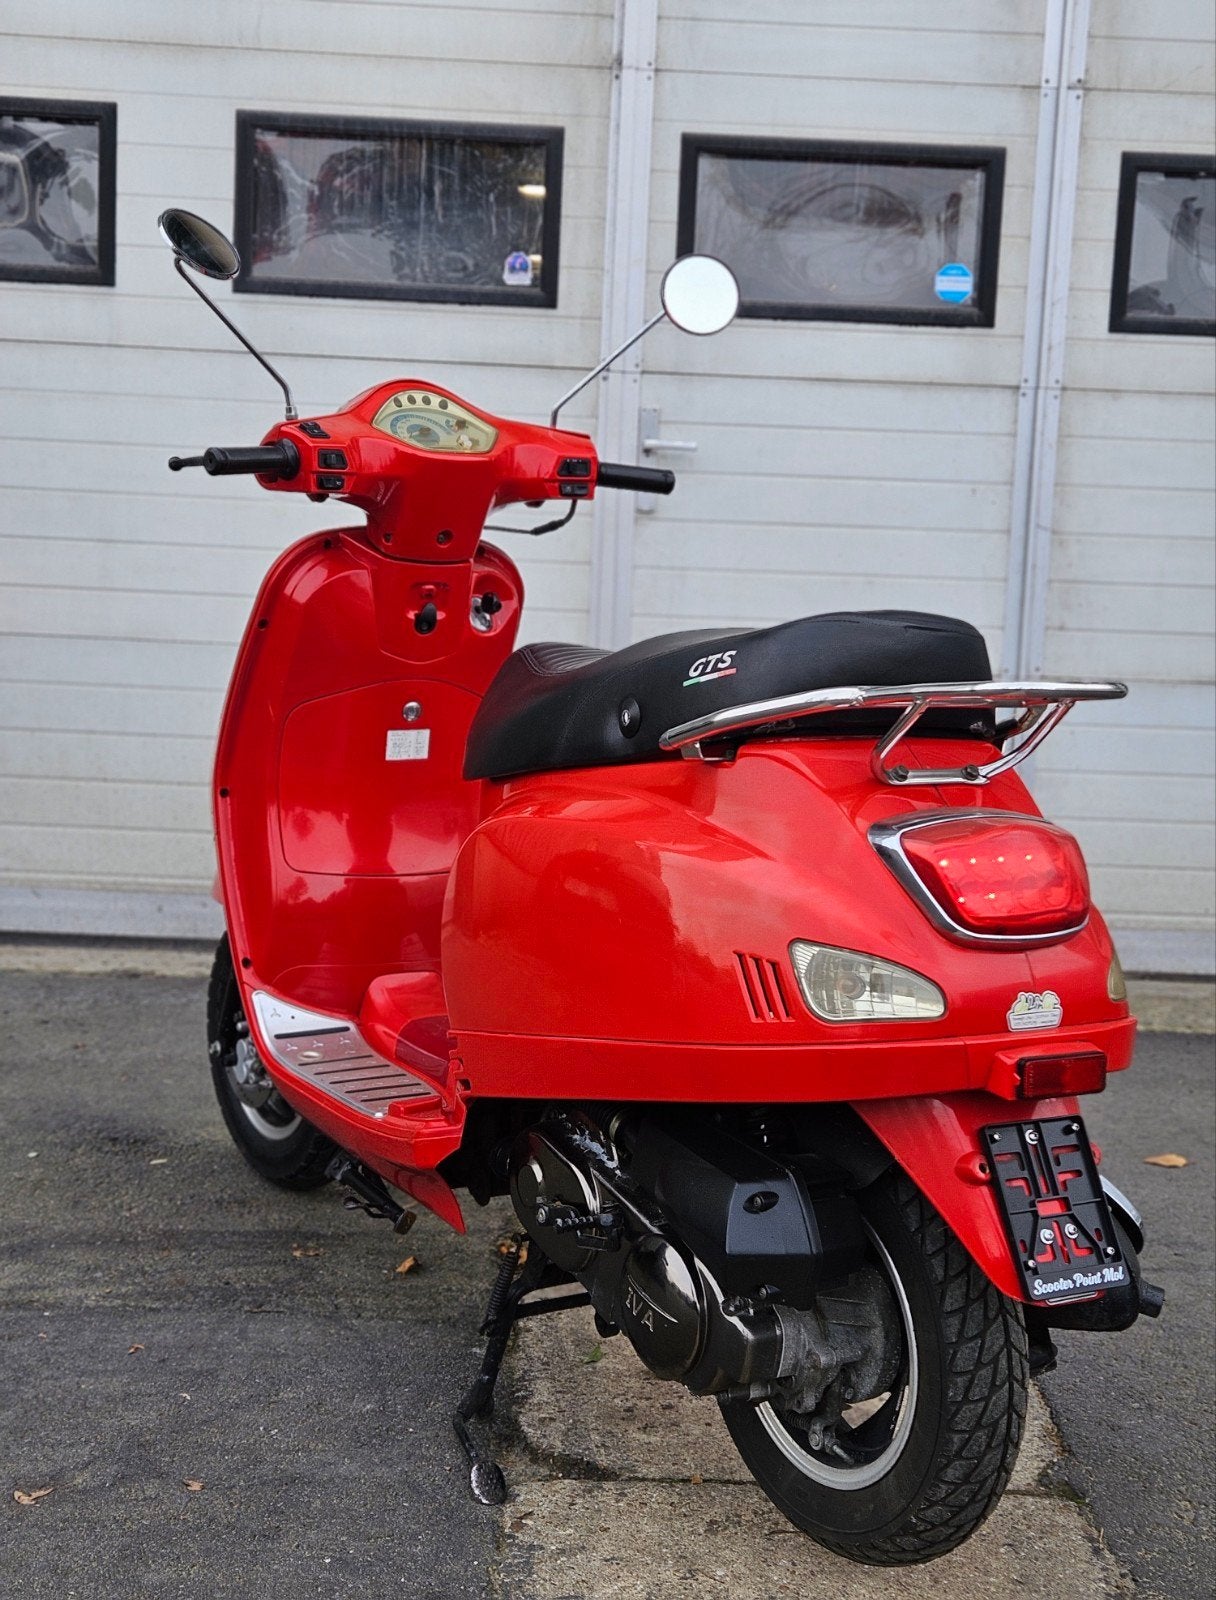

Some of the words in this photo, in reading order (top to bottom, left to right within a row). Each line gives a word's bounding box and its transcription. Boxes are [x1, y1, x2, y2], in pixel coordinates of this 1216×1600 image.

[688, 650, 737, 677] GTS
[1033, 1278, 1074, 1296] Scooter
[1073, 1270, 1102, 1288] Point
[1102, 1265, 1125, 1283] Mol
